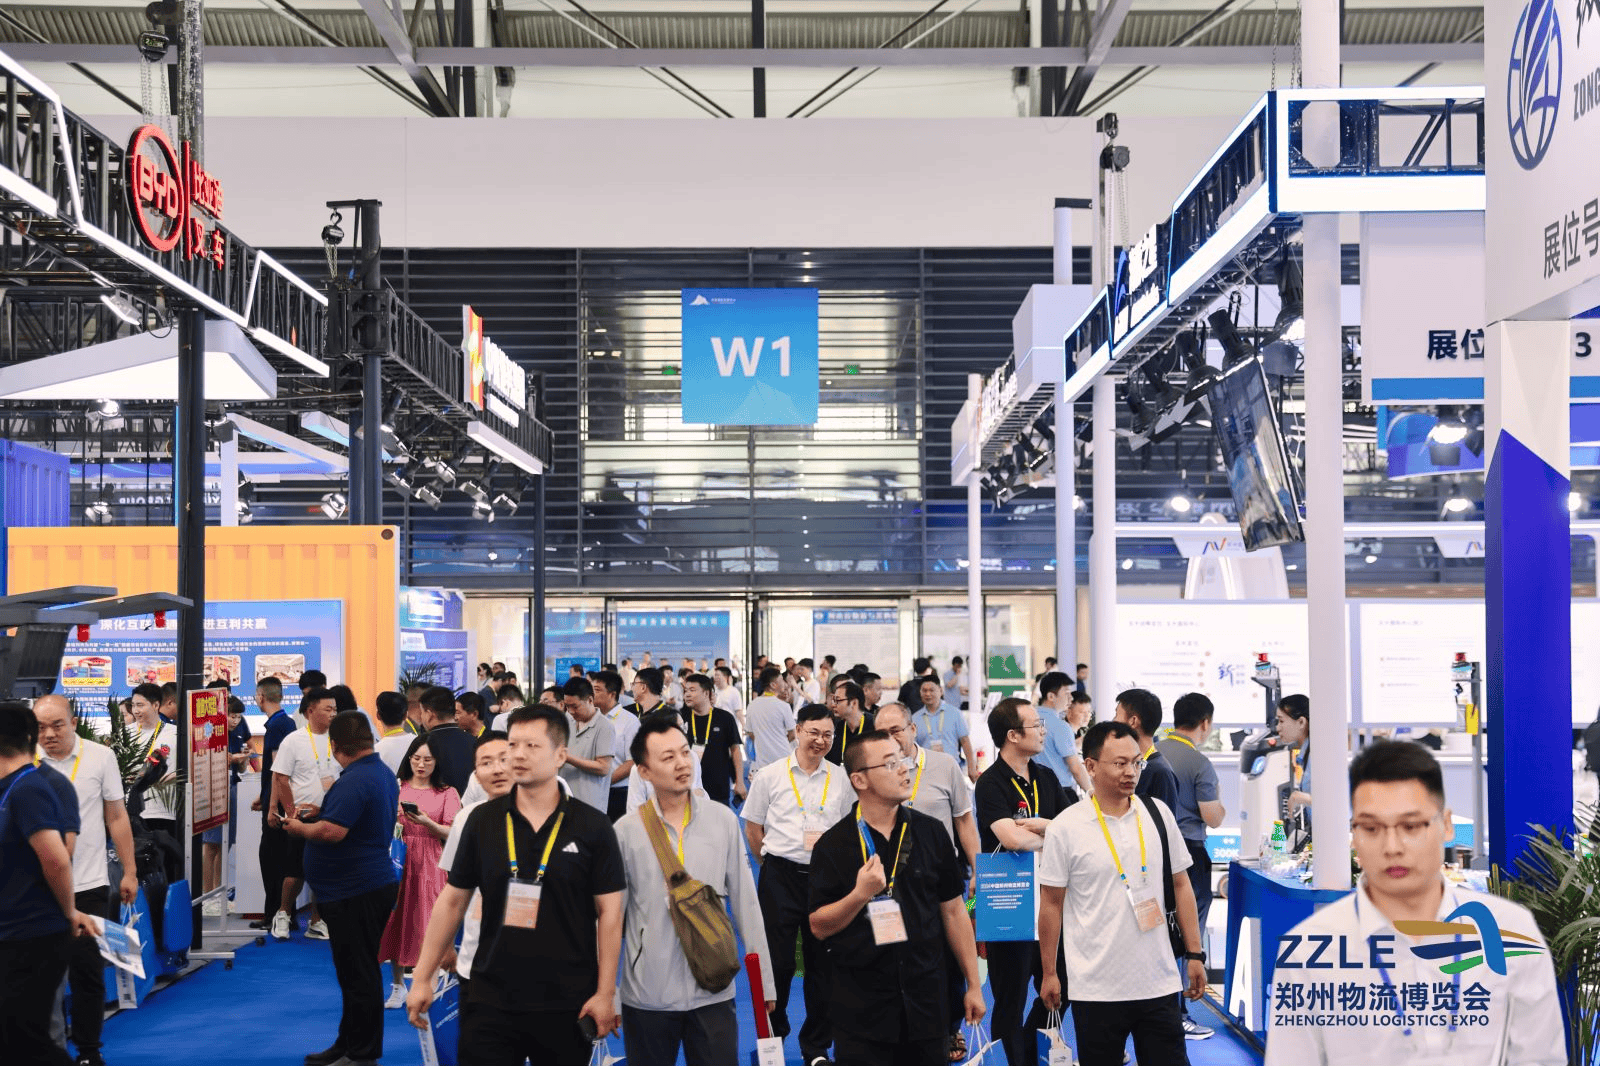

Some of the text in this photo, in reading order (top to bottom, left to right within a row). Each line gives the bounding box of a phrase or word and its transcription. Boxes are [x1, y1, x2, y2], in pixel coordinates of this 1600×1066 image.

[138, 154, 179, 219] BYD
[191, 217, 224, 271] 叉车
[1544, 198, 1600, 280] 展位号
[710, 336, 791, 377] W1
[1575, 332, 1592, 357] 3
[100, 618, 178, 631] 深化互联通
